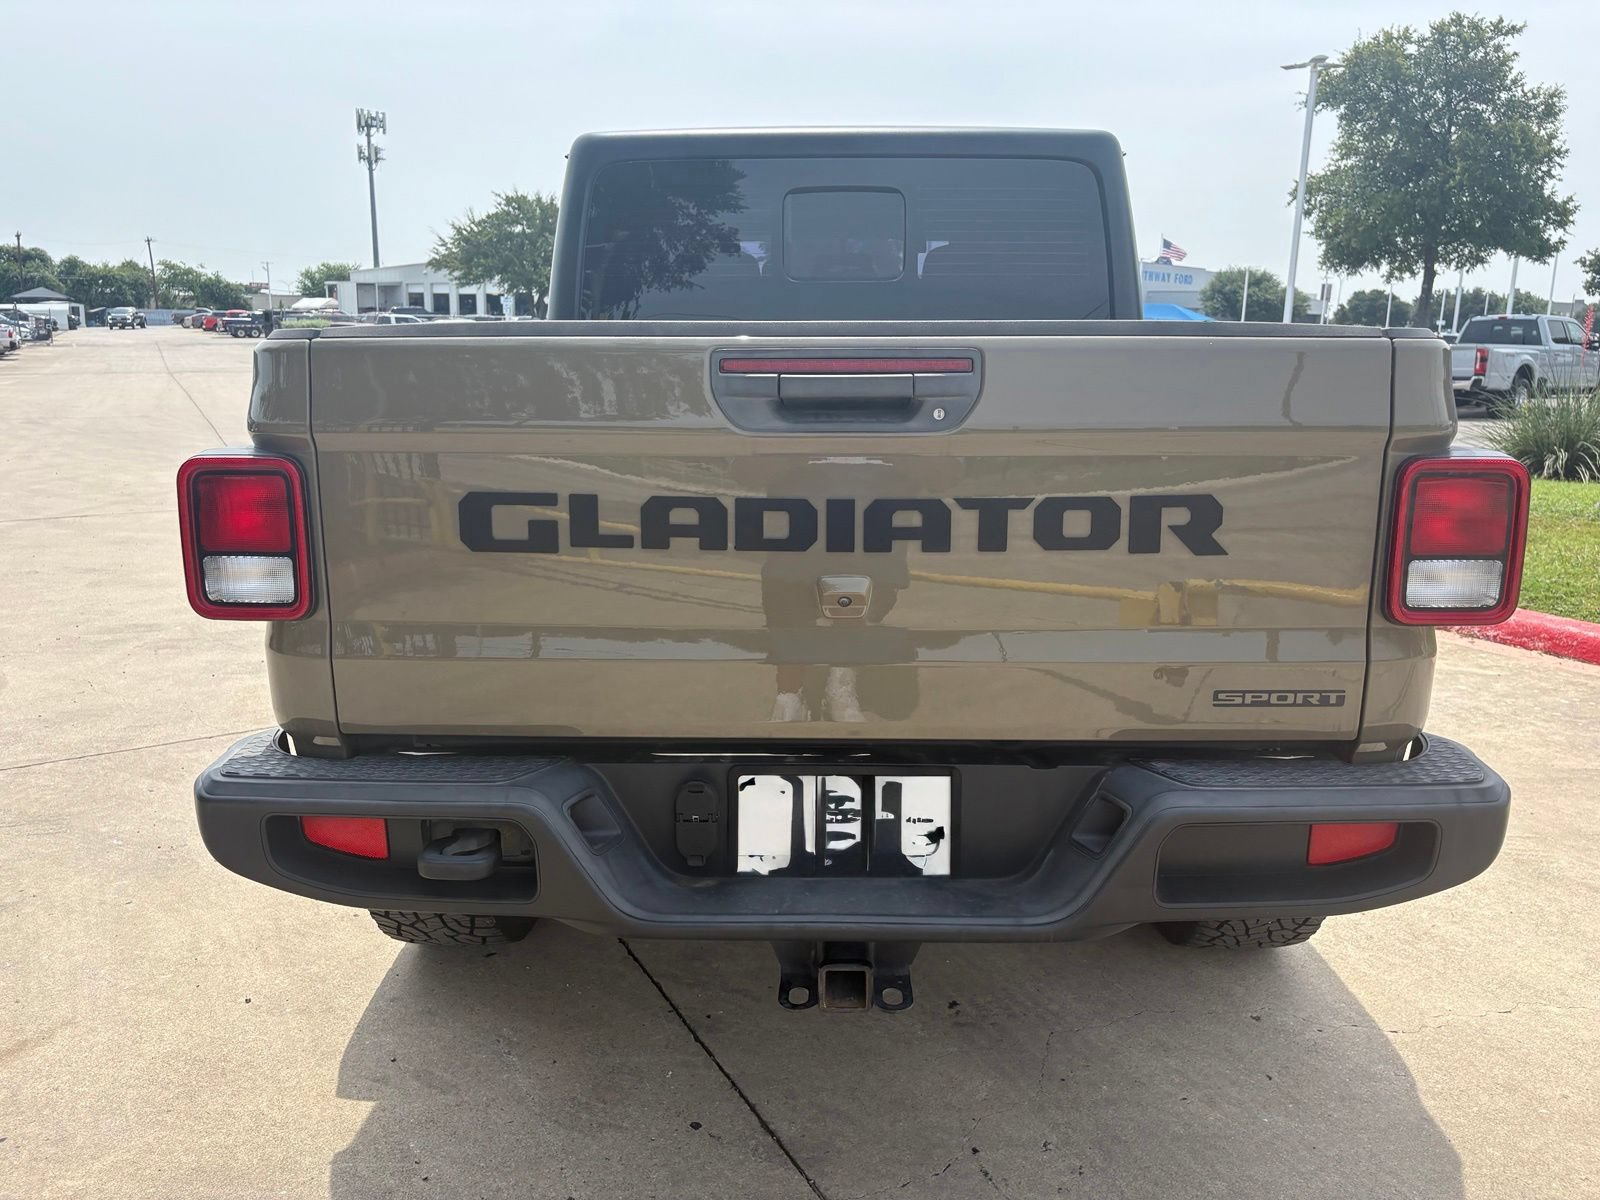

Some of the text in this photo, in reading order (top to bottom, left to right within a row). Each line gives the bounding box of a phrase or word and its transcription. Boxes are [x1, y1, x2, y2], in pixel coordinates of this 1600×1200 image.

[1174, 273, 1194, 285] FORD
[458, 491, 1229, 556] GLADIATOR
[1213, 691, 1345, 706] SPORT
